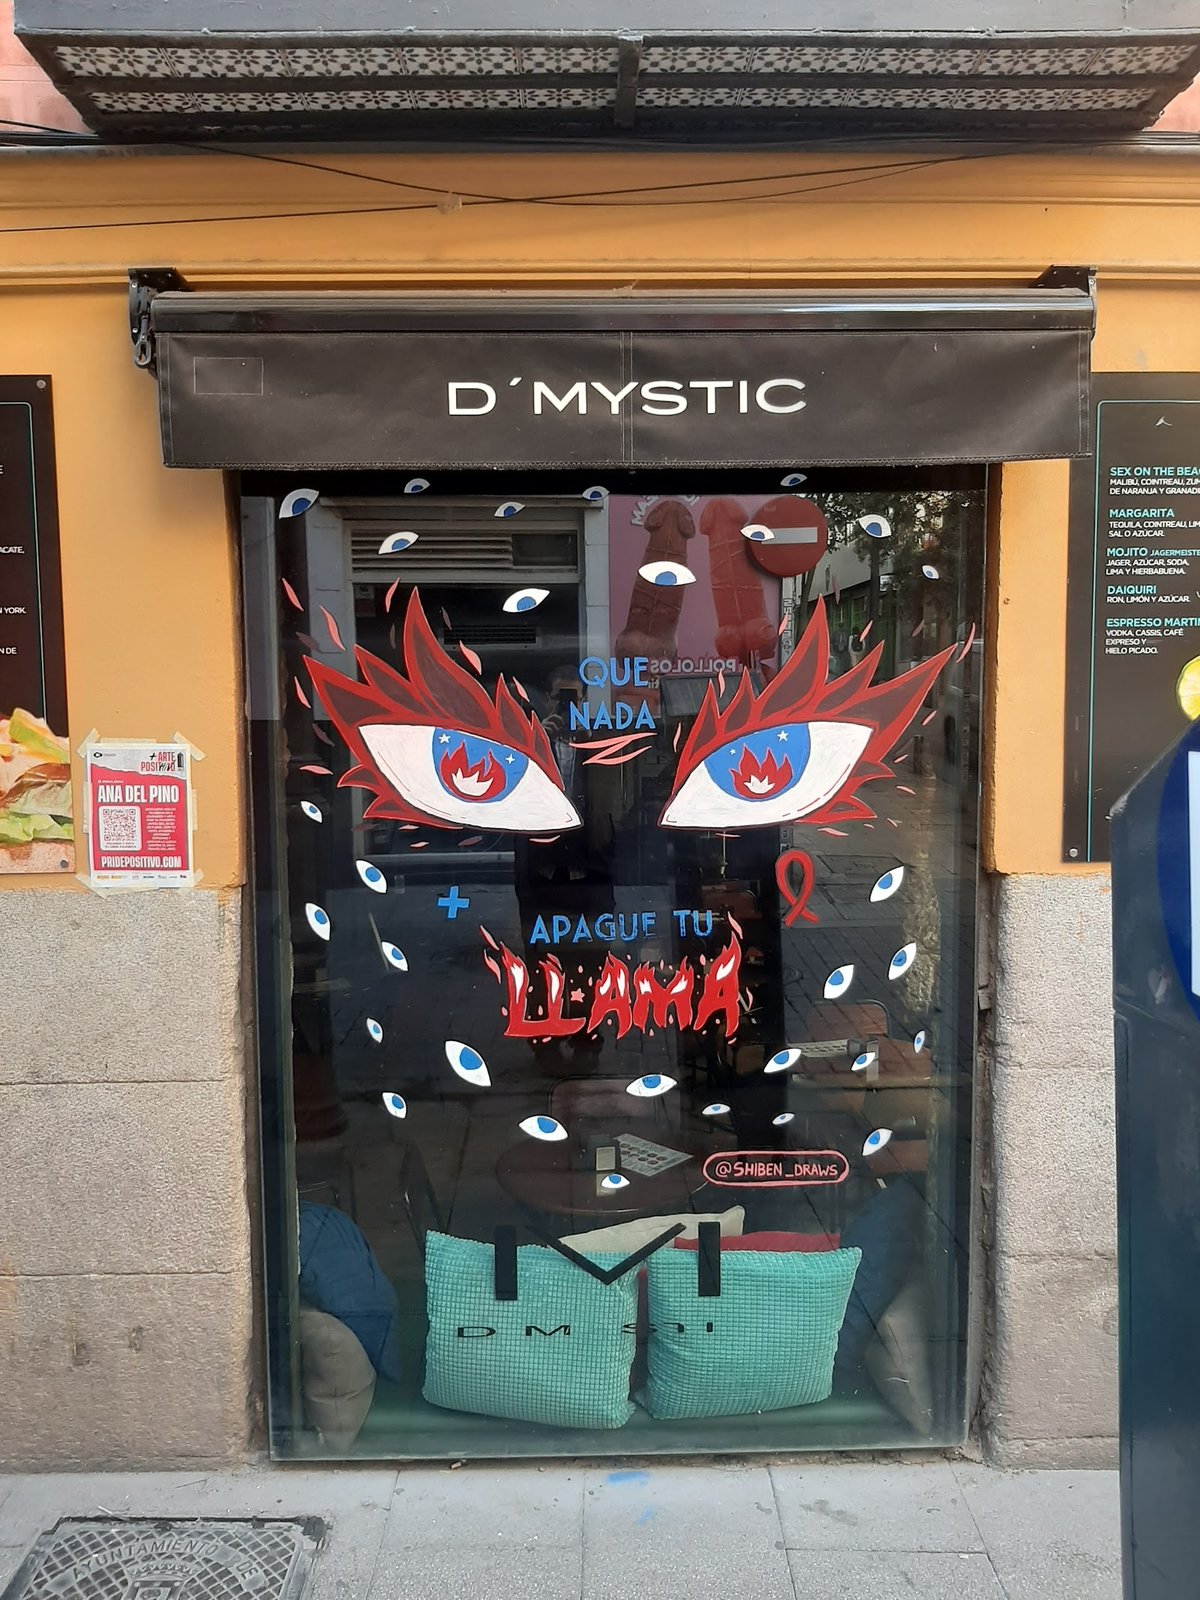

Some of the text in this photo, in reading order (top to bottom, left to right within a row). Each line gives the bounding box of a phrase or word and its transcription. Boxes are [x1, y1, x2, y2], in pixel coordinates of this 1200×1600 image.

[1109, 467, 1131, 476] SEX
[1133, 467, 1151, 476] ON
[1152, 467, 1175, 476] THE
[1109, 477, 1140, 486] MALIBÚ,
[1140, 478, 1185, 486] COINTREAU,
[1109, 487, 1121, 495] DE
[1121, 487, 1158, 495] NARANJA
[1158, 487, 1164, 495] Y
[1109, 508, 1175, 518] MARGARITA
[1143, 520, 1188, 528] COINTREAU,
[1106, 547, 1148, 557] MOJITO
[1107, 585, 1157, 594] DAIQUIRI
[1126, 595, 1150, 603] LIMÓN
[1106, 618, 1162, 627] ESPRESSO
[1163, 628, 1184, 636] CAFÉ
[6, 647, 17, 655] DE
[578, 656, 650, 688] QUE
[569, 700, 657, 731] NADA
[157, 751, 176, 762] ARTE
[97, 785, 180, 803] ANA DEL PINO
[101, 855, 182, 868] PRIDEPOSITIVO.COM
[529, 909, 713, 945] APAGUE TU
[503, 932, 742, 1040] LLAMA
[71, 1537, 220, 1579] AYUNTAMIENTO
